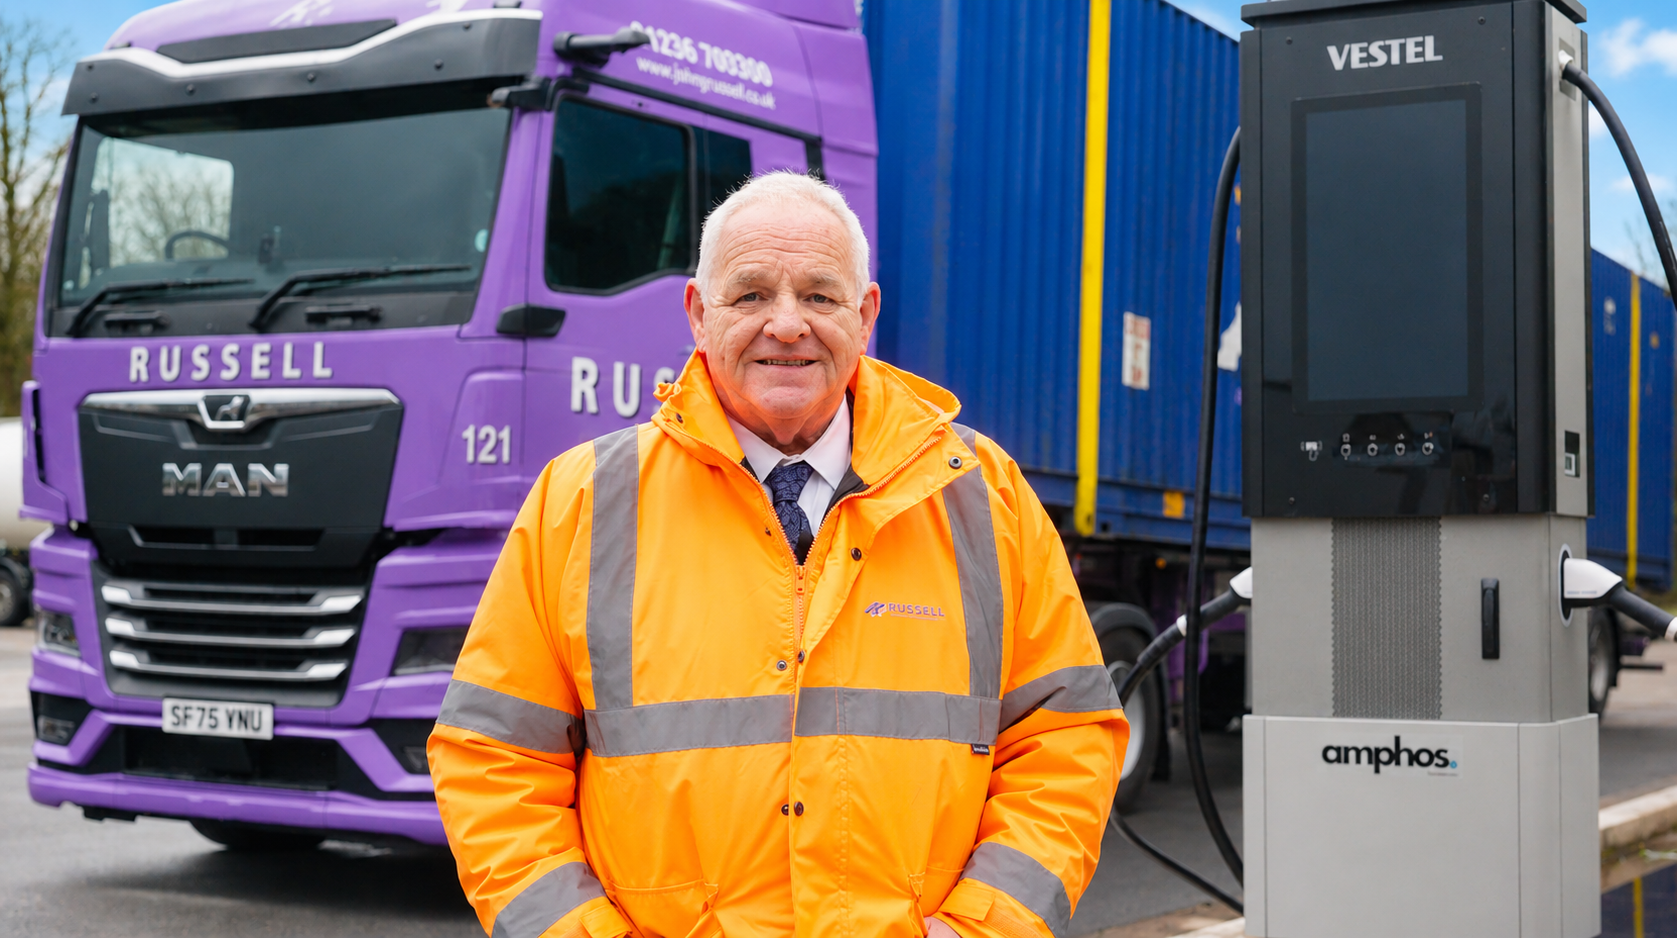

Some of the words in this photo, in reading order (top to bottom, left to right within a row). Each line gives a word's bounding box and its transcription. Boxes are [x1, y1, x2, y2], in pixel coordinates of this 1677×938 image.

[698, 41, 774, 87] 703300
[1326, 35, 1444, 71] VESTEL
[129, 341, 334, 383] RUSSELL
[462, 424, 511, 465] 121
[162, 462, 290, 498] MAN
[888, 603, 946, 618] RUSSELL
[171, 705, 220, 730] SF75
[225, 708, 263, 732] YNU
